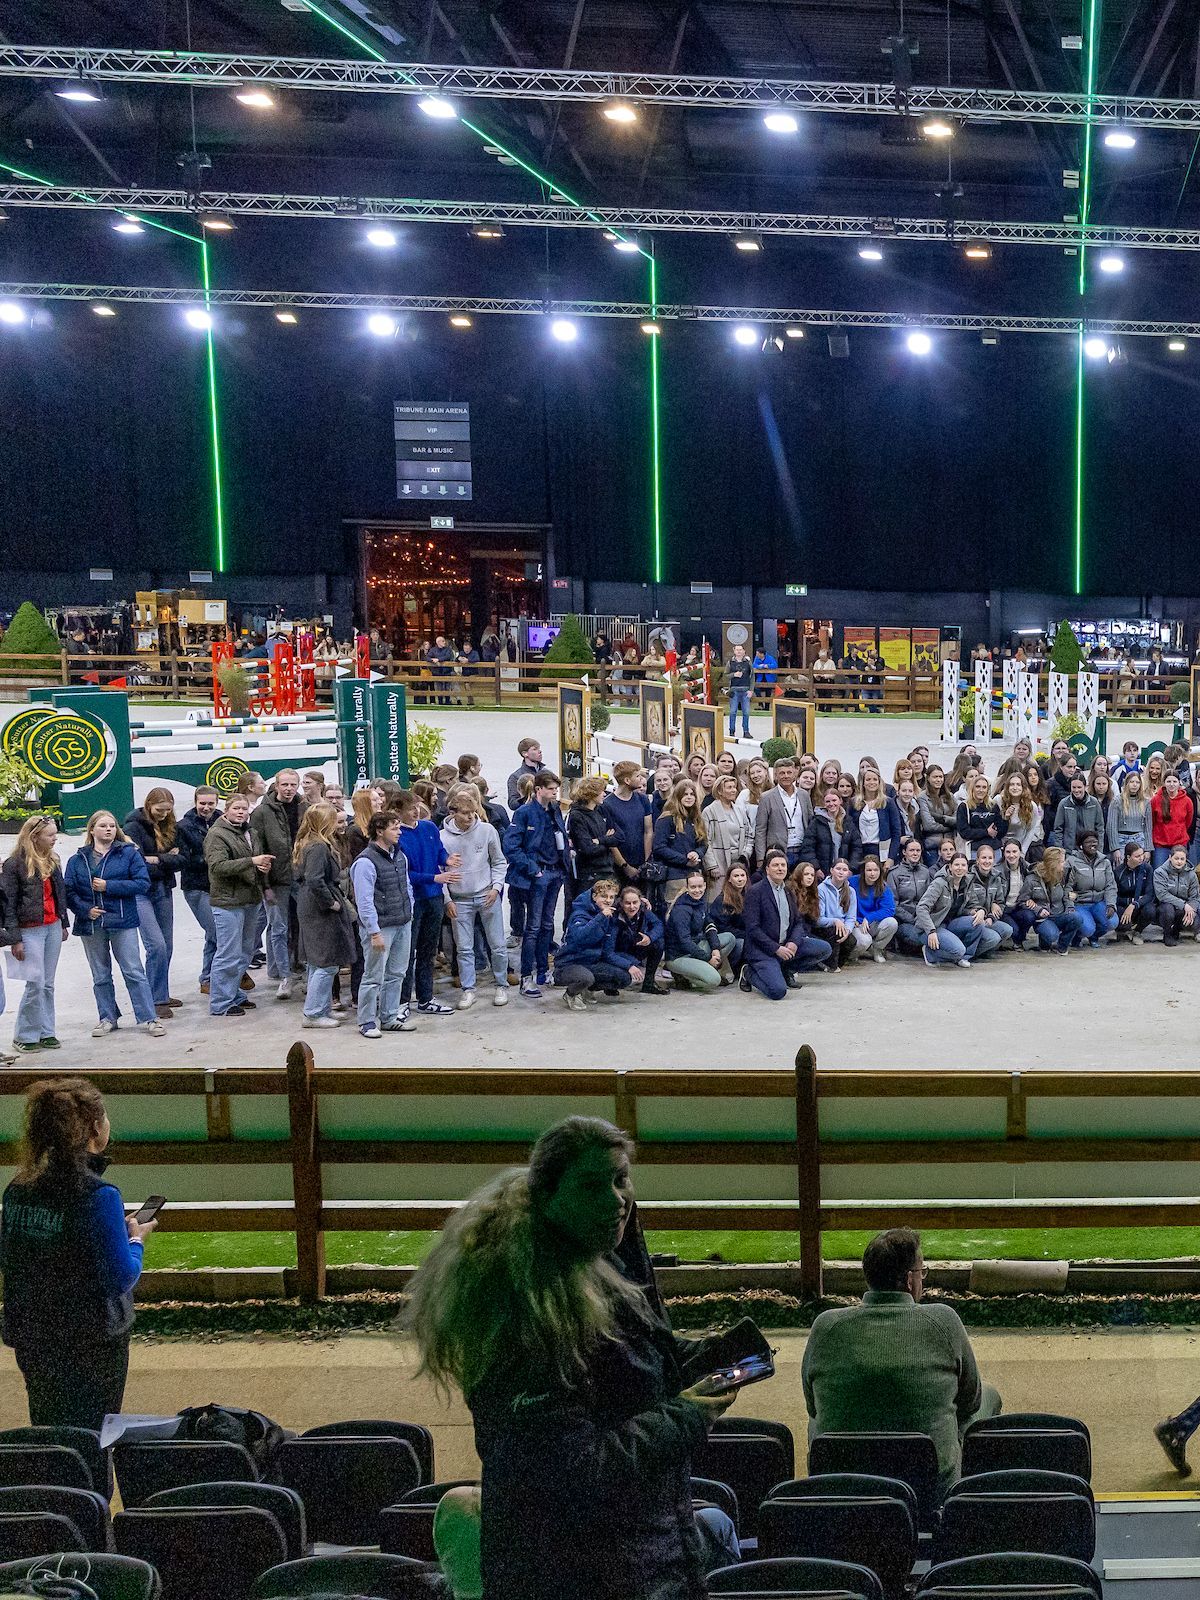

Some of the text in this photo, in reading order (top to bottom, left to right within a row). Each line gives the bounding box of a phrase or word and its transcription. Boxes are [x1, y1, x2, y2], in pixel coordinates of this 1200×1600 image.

[387, 691, 399, 739] Naturally
[35, 722, 94, 761] De Sutter Naturally
[356, 733, 366, 765] Sutter
[390, 741, 400, 773] Sutter
[357, 766, 366, 780] De
